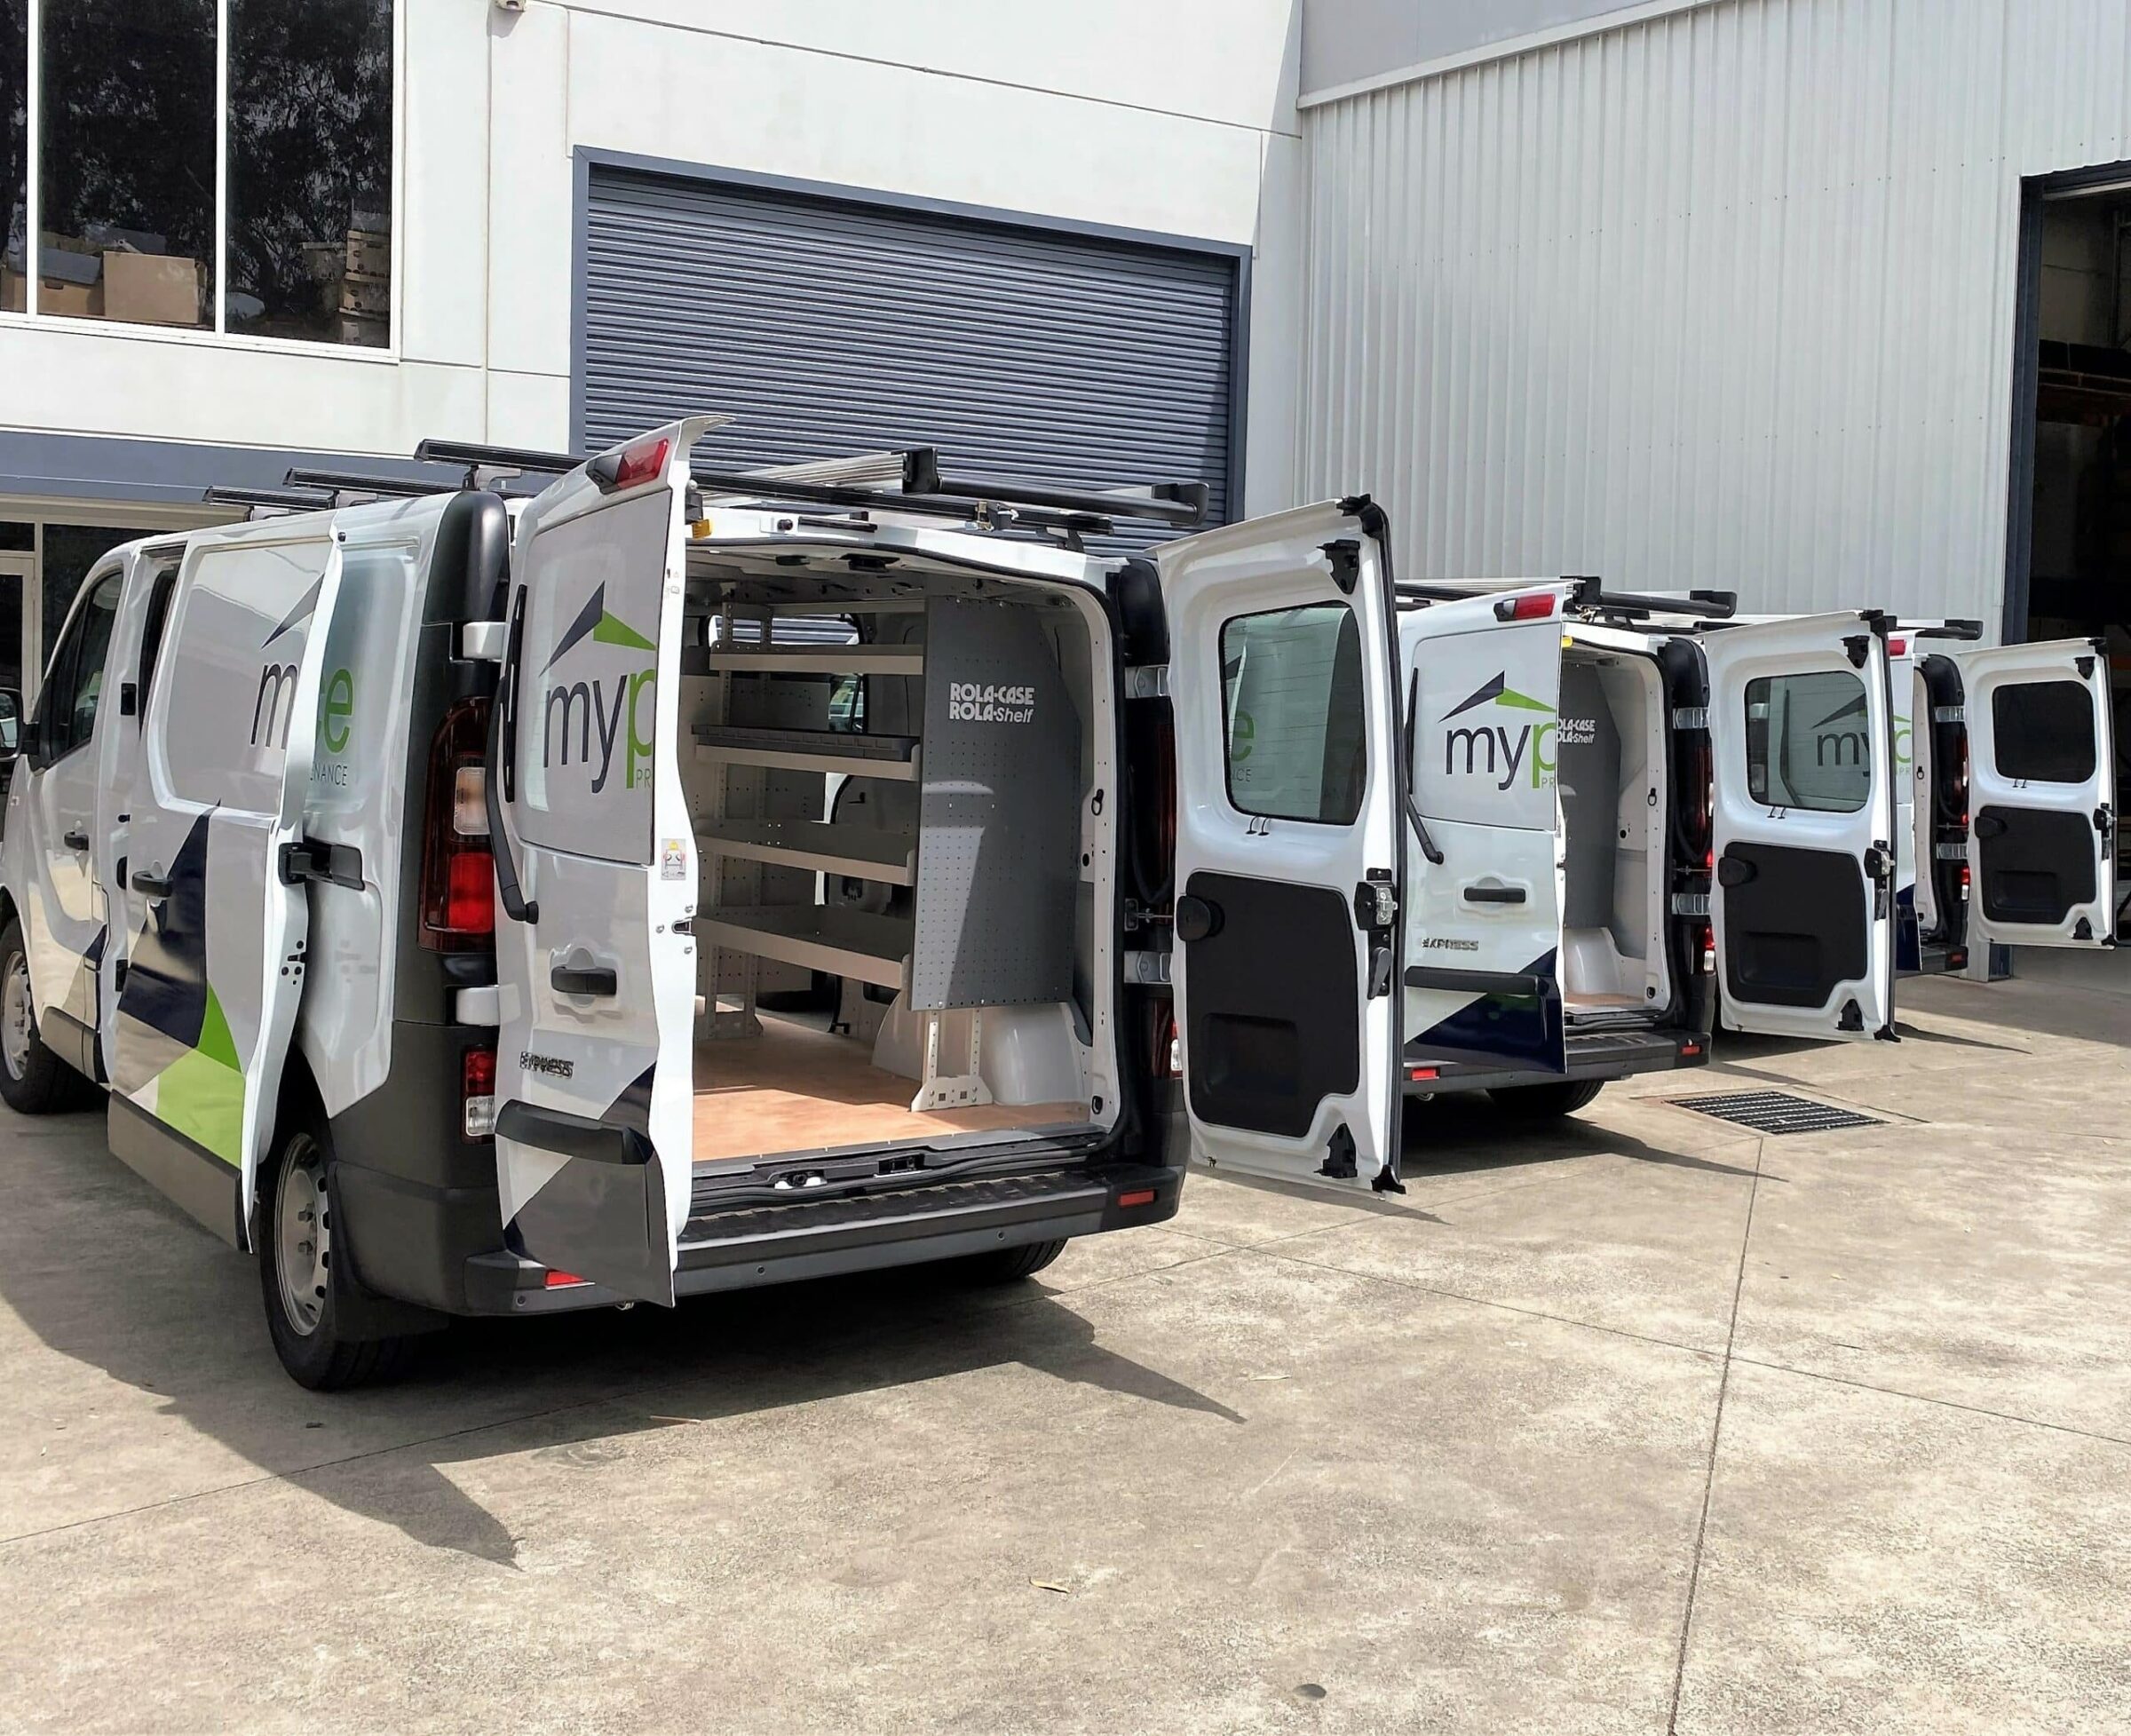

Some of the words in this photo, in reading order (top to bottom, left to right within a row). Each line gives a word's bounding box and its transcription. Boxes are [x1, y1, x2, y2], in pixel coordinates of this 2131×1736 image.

[316, 668, 353, 754] e
[543, 669, 655, 794] myp
[1446, 722, 1556, 791] myp
